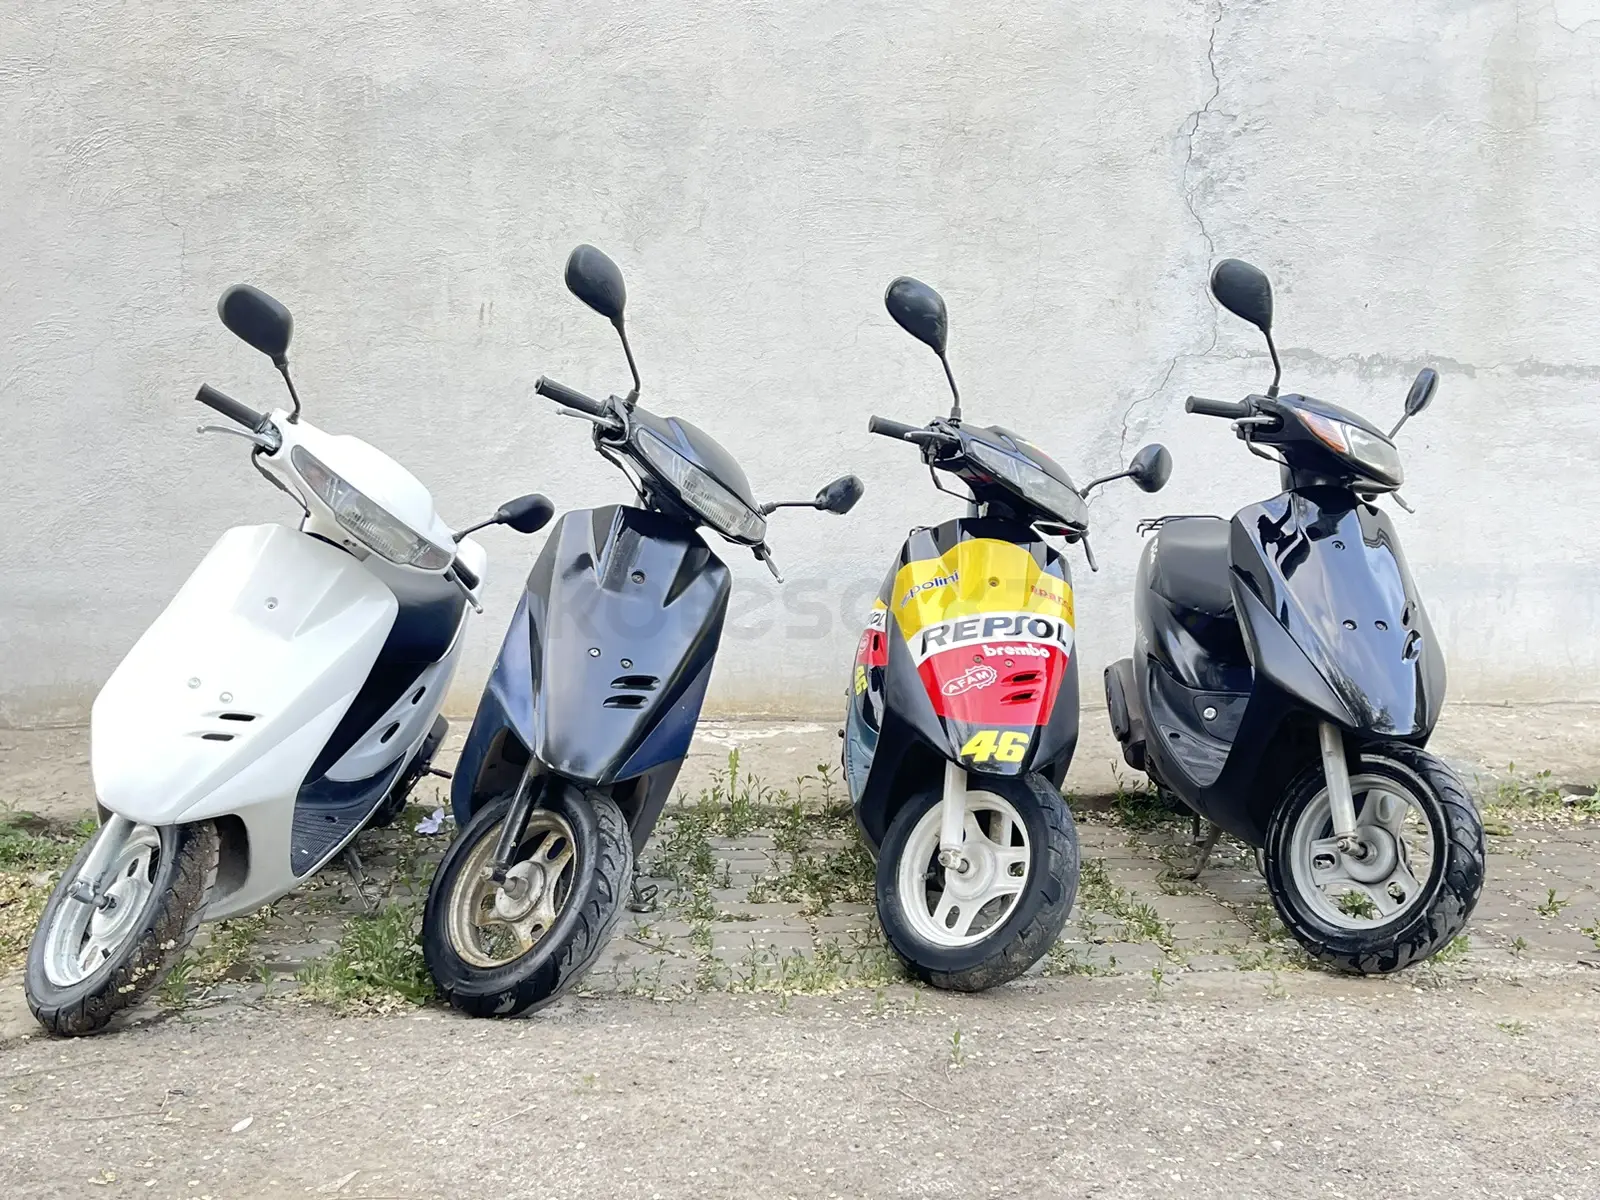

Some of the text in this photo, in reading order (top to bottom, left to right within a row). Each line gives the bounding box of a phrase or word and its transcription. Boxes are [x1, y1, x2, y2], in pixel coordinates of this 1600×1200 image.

[909, 569, 959, 599] polini
[920, 615, 1068, 657] REPSOL
[982, 644, 1051, 659] brembo
[949, 669, 989, 694] AFAM
[960, 729, 1030, 763] 46
